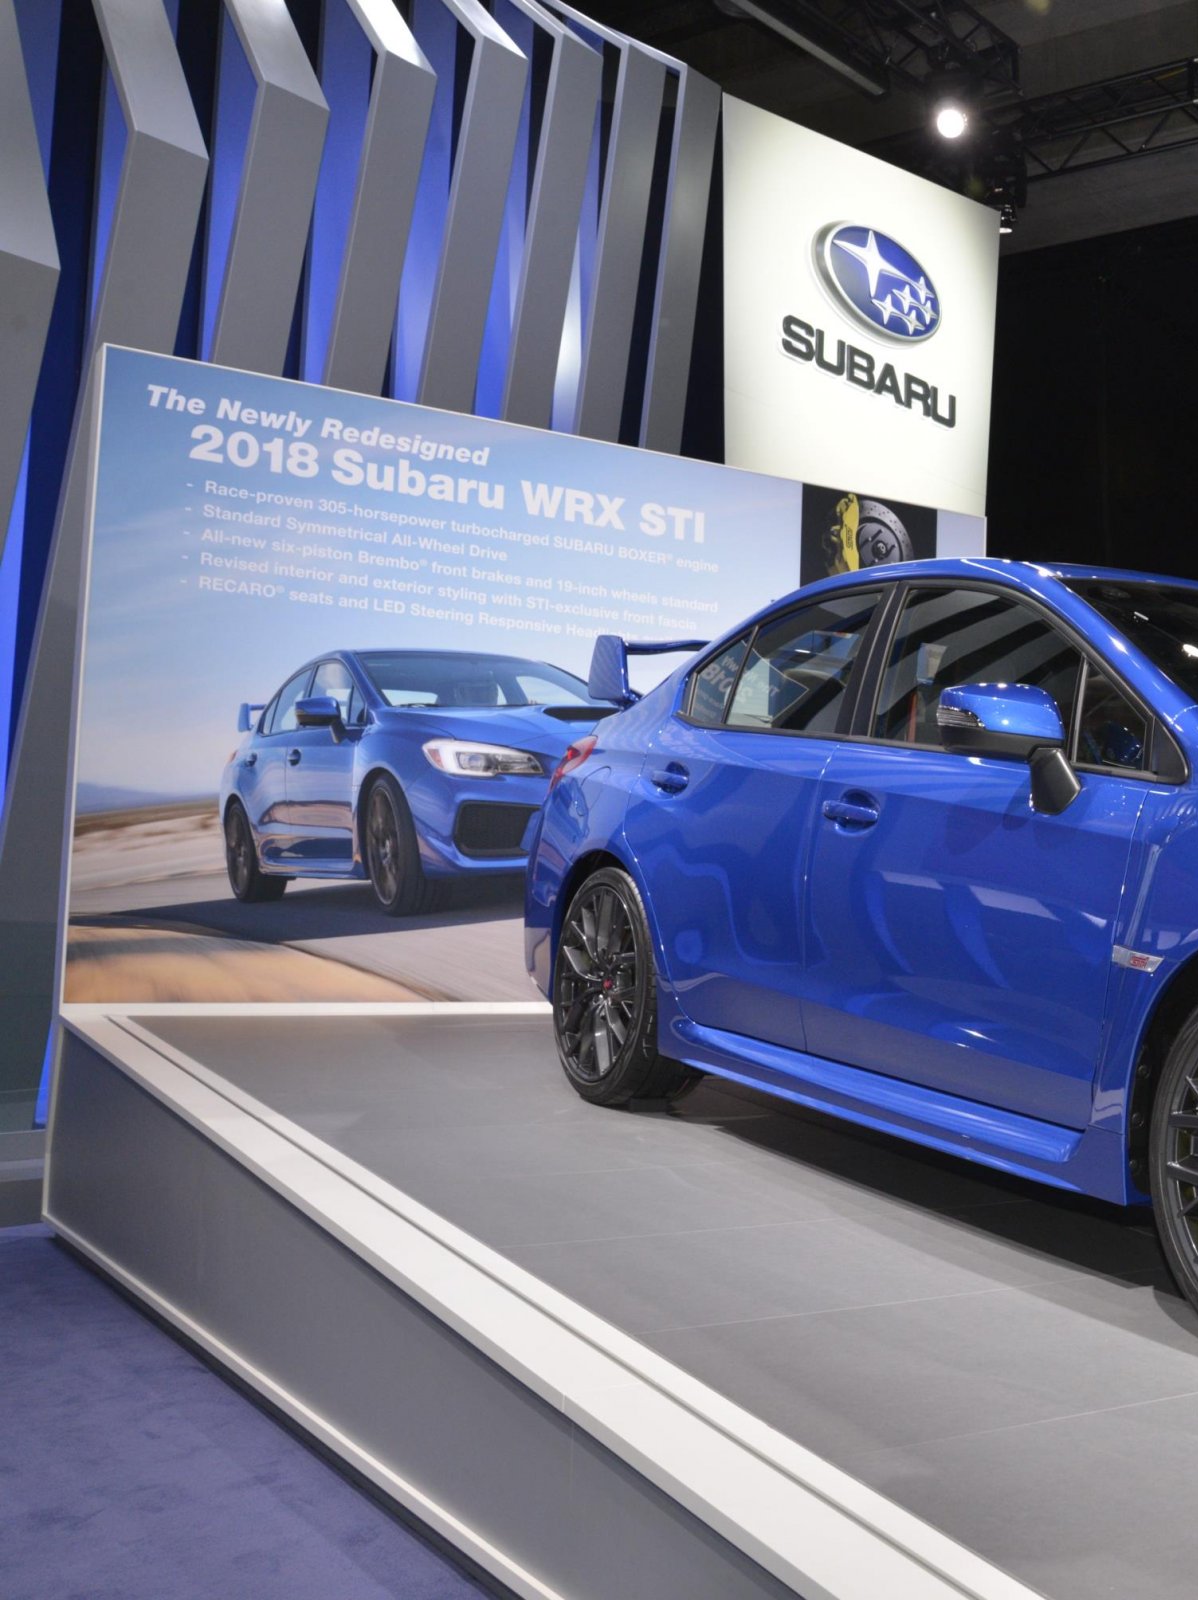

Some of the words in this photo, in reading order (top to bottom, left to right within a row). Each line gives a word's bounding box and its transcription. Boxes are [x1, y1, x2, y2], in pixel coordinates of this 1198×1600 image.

[781, 315, 956, 428] SUBARU
[147, 384, 206, 415] The
[216, 398, 312, 437] Newly
[320, 417, 490, 467] Redesigned
[189, 424, 320, 479] 2018
[331, 448, 504, 510] Subaru
[521, 480, 626, 530] WRX
[639, 502, 705, 544] STI
[202, 503, 281, 528] Standard
[286, 516, 387, 543] Symmetrical
[391, 533, 465, 555] All-Wheel
[469, 544, 508, 561] Drive
[205, 480, 313, 510] Race-proven
[318, 498, 447, 530] 305-horsepower
[451, 520, 549, 546] turbocharged
[553, 535, 614, 556] SUBARU
[676, 557, 719, 573] engine
[200, 551, 269, 574] Revised
[274, 561, 334, 582] interior
[338, 573, 368, 587] and
[373, 577, 434, 595] exterior
[438, 586, 487, 605] styling
[491, 593, 522, 607] with
[526, 596, 619, 621] STI-exclusive
[623, 609, 655, 625] front
[658, 615, 697, 631] fascia
[201, 528, 267, 549] All-new
[271, 539, 352, 561] six-piston
[431, 561, 467, 578] front
[471, 567, 522, 585] brakes
[525, 576, 552, 590] and
[557, 579, 607, 598] 19-inch
[611, 587, 658, 605] wheels
[662, 596, 718, 614] standard
[289, 590, 333, 606] seats
[338, 595, 369, 610] and
[373, 598, 405, 614] LED
[410, 602, 474, 625] Steering
[478, 611, 562, 634] Responsive
